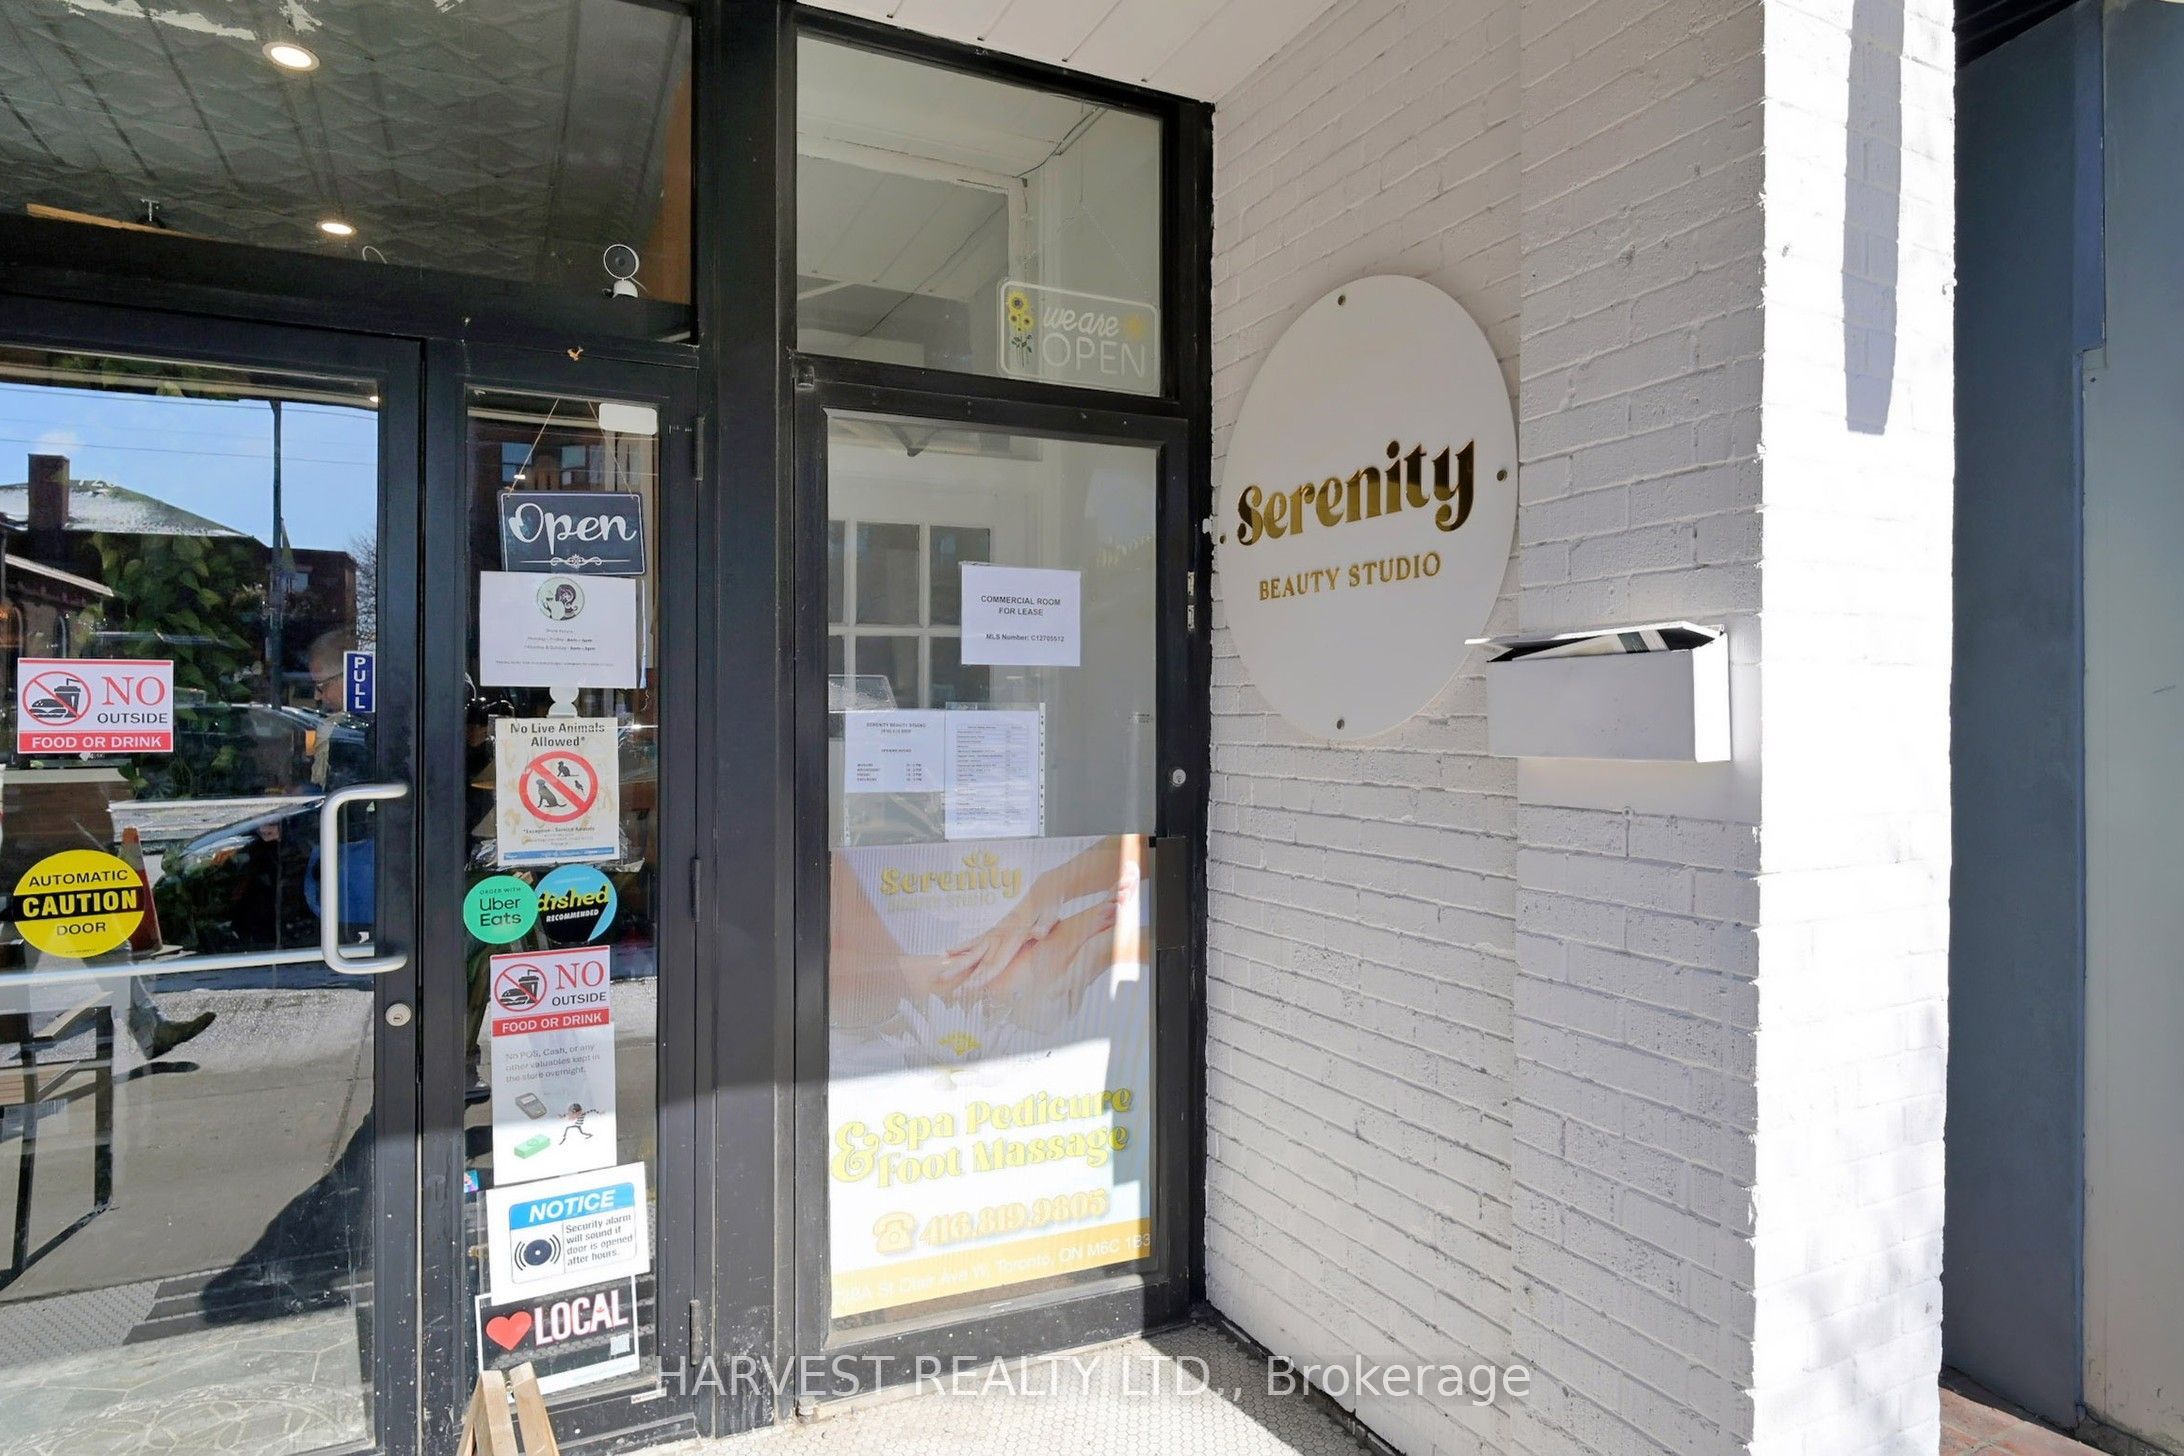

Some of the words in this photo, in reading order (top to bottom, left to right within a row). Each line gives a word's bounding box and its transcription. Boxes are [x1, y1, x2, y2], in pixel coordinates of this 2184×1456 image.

[1043, 306, 1078, 331] we
[1077, 312, 1119, 337] are
[1042, 332, 1145, 378] OPEN
[1237, 437, 1474, 546] Serenity
[508, 502, 637, 555] Open
[1259, 567, 1340, 601] BEAUTY
[1348, 551, 1441, 587] STUDIO
[981, 595, 1034, 605] COMMERCIAL
[1037, 597, 1061, 606] ROOM
[998, 607, 1015, 615] FOR
[1017, 607, 1043, 616] LEASE
[985, 633, 1000, 641] MLS
[1002, 633, 1029, 641] Number:
[101, 675, 166, 707] NO
[353, 656, 366, 711] PULL
[97, 711, 168, 725] OUTSIDE
[510, 722, 528, 734] No
[531, 722, 555, 734] Live
[558, 722, 605, 733] Animals
[31, 735, 77, 749] FOOD
[82, 735, 106, 749] OR
[111, 734, 162, 748] DRINK
[28, 869, 129, 889] AUTOMATIC
[880, 866, 1022, 899] Serenity
[22, 888, 137, 919] CAUTION
[480, 897, 520, 911] Uber
[538, 884, 609, 912] dished
[480, 912, 521, 927] Eats
[546, 908, 600, 923] RECOMMENDED
[56, 921, 107, 936] DOOR
[555, 960, 605, 990] NO
[551, 991, 607, 1007] OUTSIDE
[502, 1020, 537, 1033] FOOD
[540, 1017, 558, 1028] OR
[563, 1012, 602, 1026] DRINK
[543, 1047, 567, 1056] Cash,
[580, 1044, 595, 1052] any
[531, 1057, 571, 1068] valuables
[572, 1055, 590, 1063] kept
[522, 1072, 543, 1080] store
[831, 1120, 880, 1183] &
[881, 1112, 955, 1151] Spa
[965, 1088, 1133, 1136] Pedicure
[877, 1146, 963, 1188] Foot
[972, 1125, 1130, 1173] Massage
[528, 1189, 616, 1223] NOTICE
[565, 1220, 603, 1234] Security
[605, 1214, 631, 1225] alarm
[566, 1233, 583, 1244] will
[585, 1228, 613, 1241] sound
[614, 1225, 621, 1234] if
[566, 1245, 587, 1255] door
[590, 1242, 598, 1250] is
[600, 1234, 633, 1248] opened
[567, 1255, 588, 1266] after
[1058, 1247, 1085, 1263] ON
[534, 1289, 629, 1346] LOCAL
